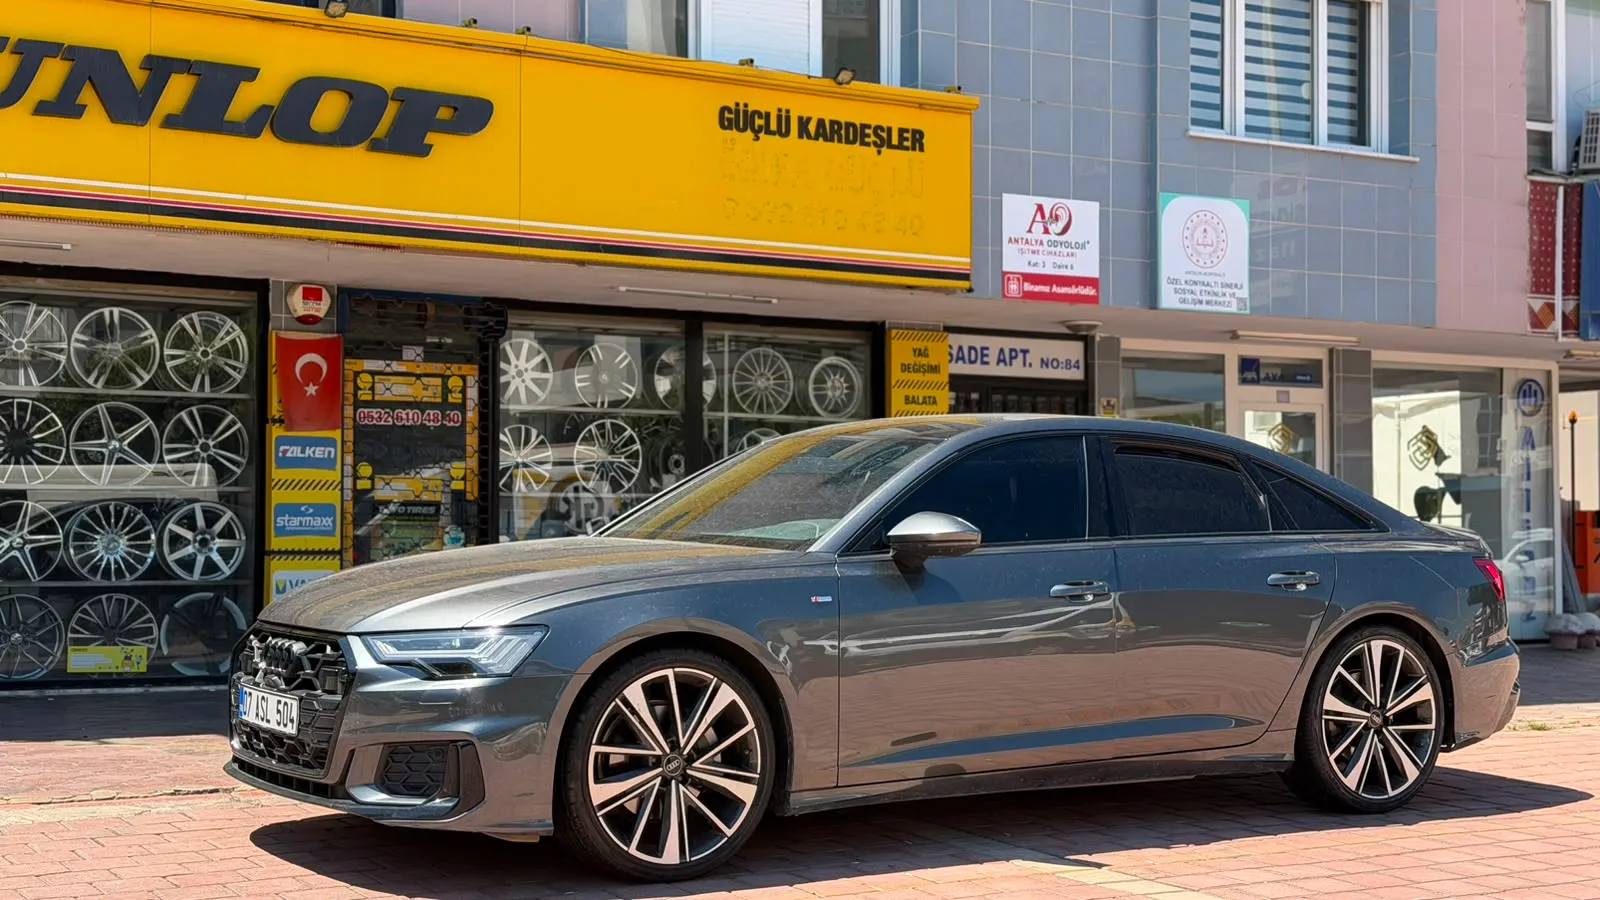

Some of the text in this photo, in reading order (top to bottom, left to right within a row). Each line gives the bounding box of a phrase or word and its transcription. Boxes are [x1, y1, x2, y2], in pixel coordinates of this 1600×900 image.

[718, 102, 925, 156] GÜÇLÜ KARDEŞLER
[1007, 236, 1044, 247] ANTALYA
[1167, 276, 1183, 286] ÖZEL
[1173, 287, 1198, 297] SOSYAL
[912, 345, 929, 358] YAĞ
[996, 347, 1032, 368] APT.
[1040, 357, 1081, 370] NO:84
[900, 361, 941, 376] DEĞİŞİMİ
[904, 394, 937, 406] BALATA
[357, 408, 392, 425] 0532
[394, 409, 421, 425] 610
[423, 411, 441, 426] 48
[278, 445, 336, 459] FALKEN
[407, 505, 437, 514] TIRES
[276, 514, 334, 528] starmaxx
[243, 690, 295, 730] 07 ASL 504
